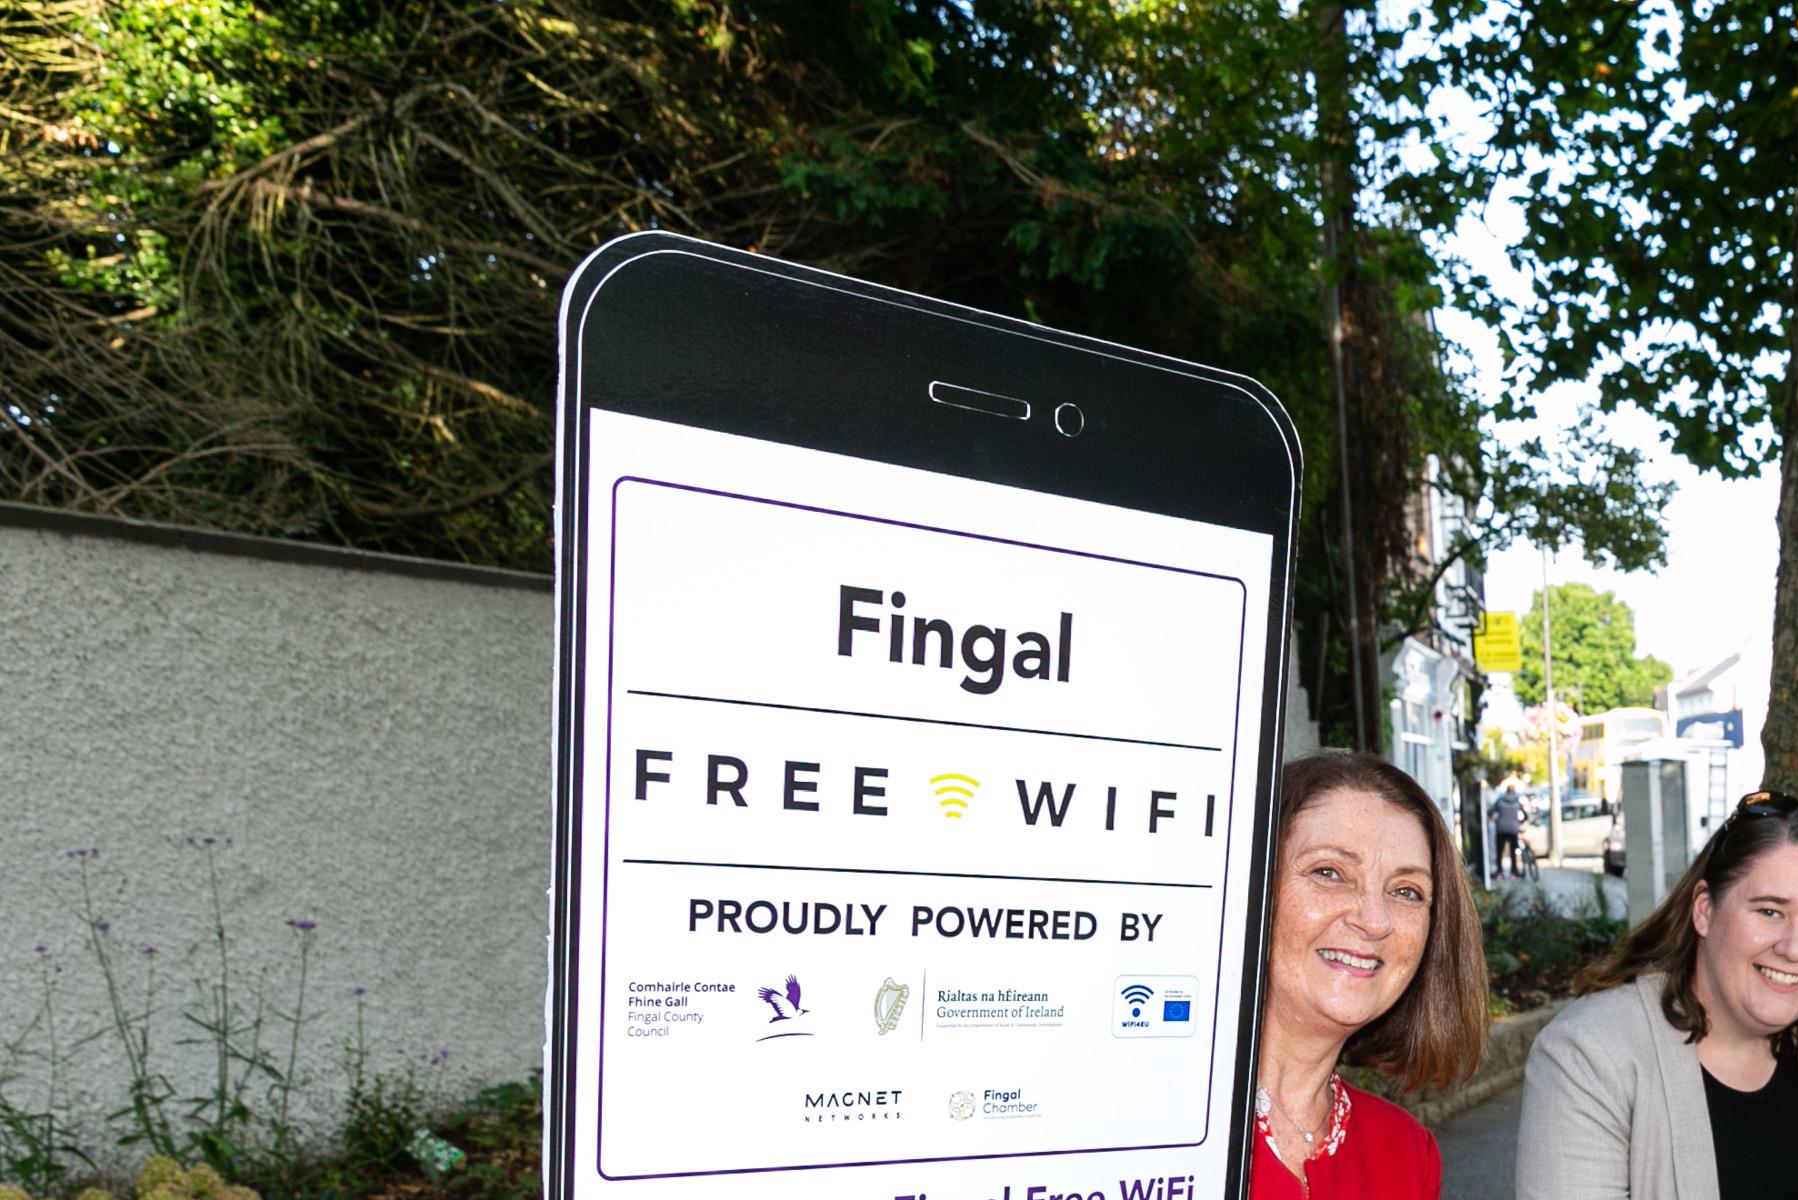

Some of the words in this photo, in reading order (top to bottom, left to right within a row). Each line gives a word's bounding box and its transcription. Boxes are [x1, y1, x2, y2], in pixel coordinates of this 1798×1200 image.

[838, 585, 1072, 695] Fingal
[635, 749, 888, 816] FREE
[1016, 779, 1215, 837] WIFI
[689, 899, 887, 935] PROUDLY
[912, 906, 1097, 940] POWERED
[1121, 913, 1163, 941] BY
[628, 981, 691, 993] Comhairle
[693, 982, 736, 993] Contae
[628, 996, 662, 1008] Fhine
[664, 996, 688, 1008] Gall
[937, 989, 978, 1003] Rialtas
[980, 993, 995, 1002] na
[997, 988, 1049, 1002] hÉireann
[628, 1011, 661, 1026] Fingal
[663, 1011, 705, 1025] County
[936, 1006, 1009, 1019] Government
[1010, 1004, 1026, 1018] of
[1026, 1005, 1065, 1018] Ireland
[627, 1025, 669, 1037] Council
[983, 1088, 1021, 1105] Fingal
[982, 1099, 1038, 1114] Chamber
[804, 1111, 901, 1123] NETWORKS
